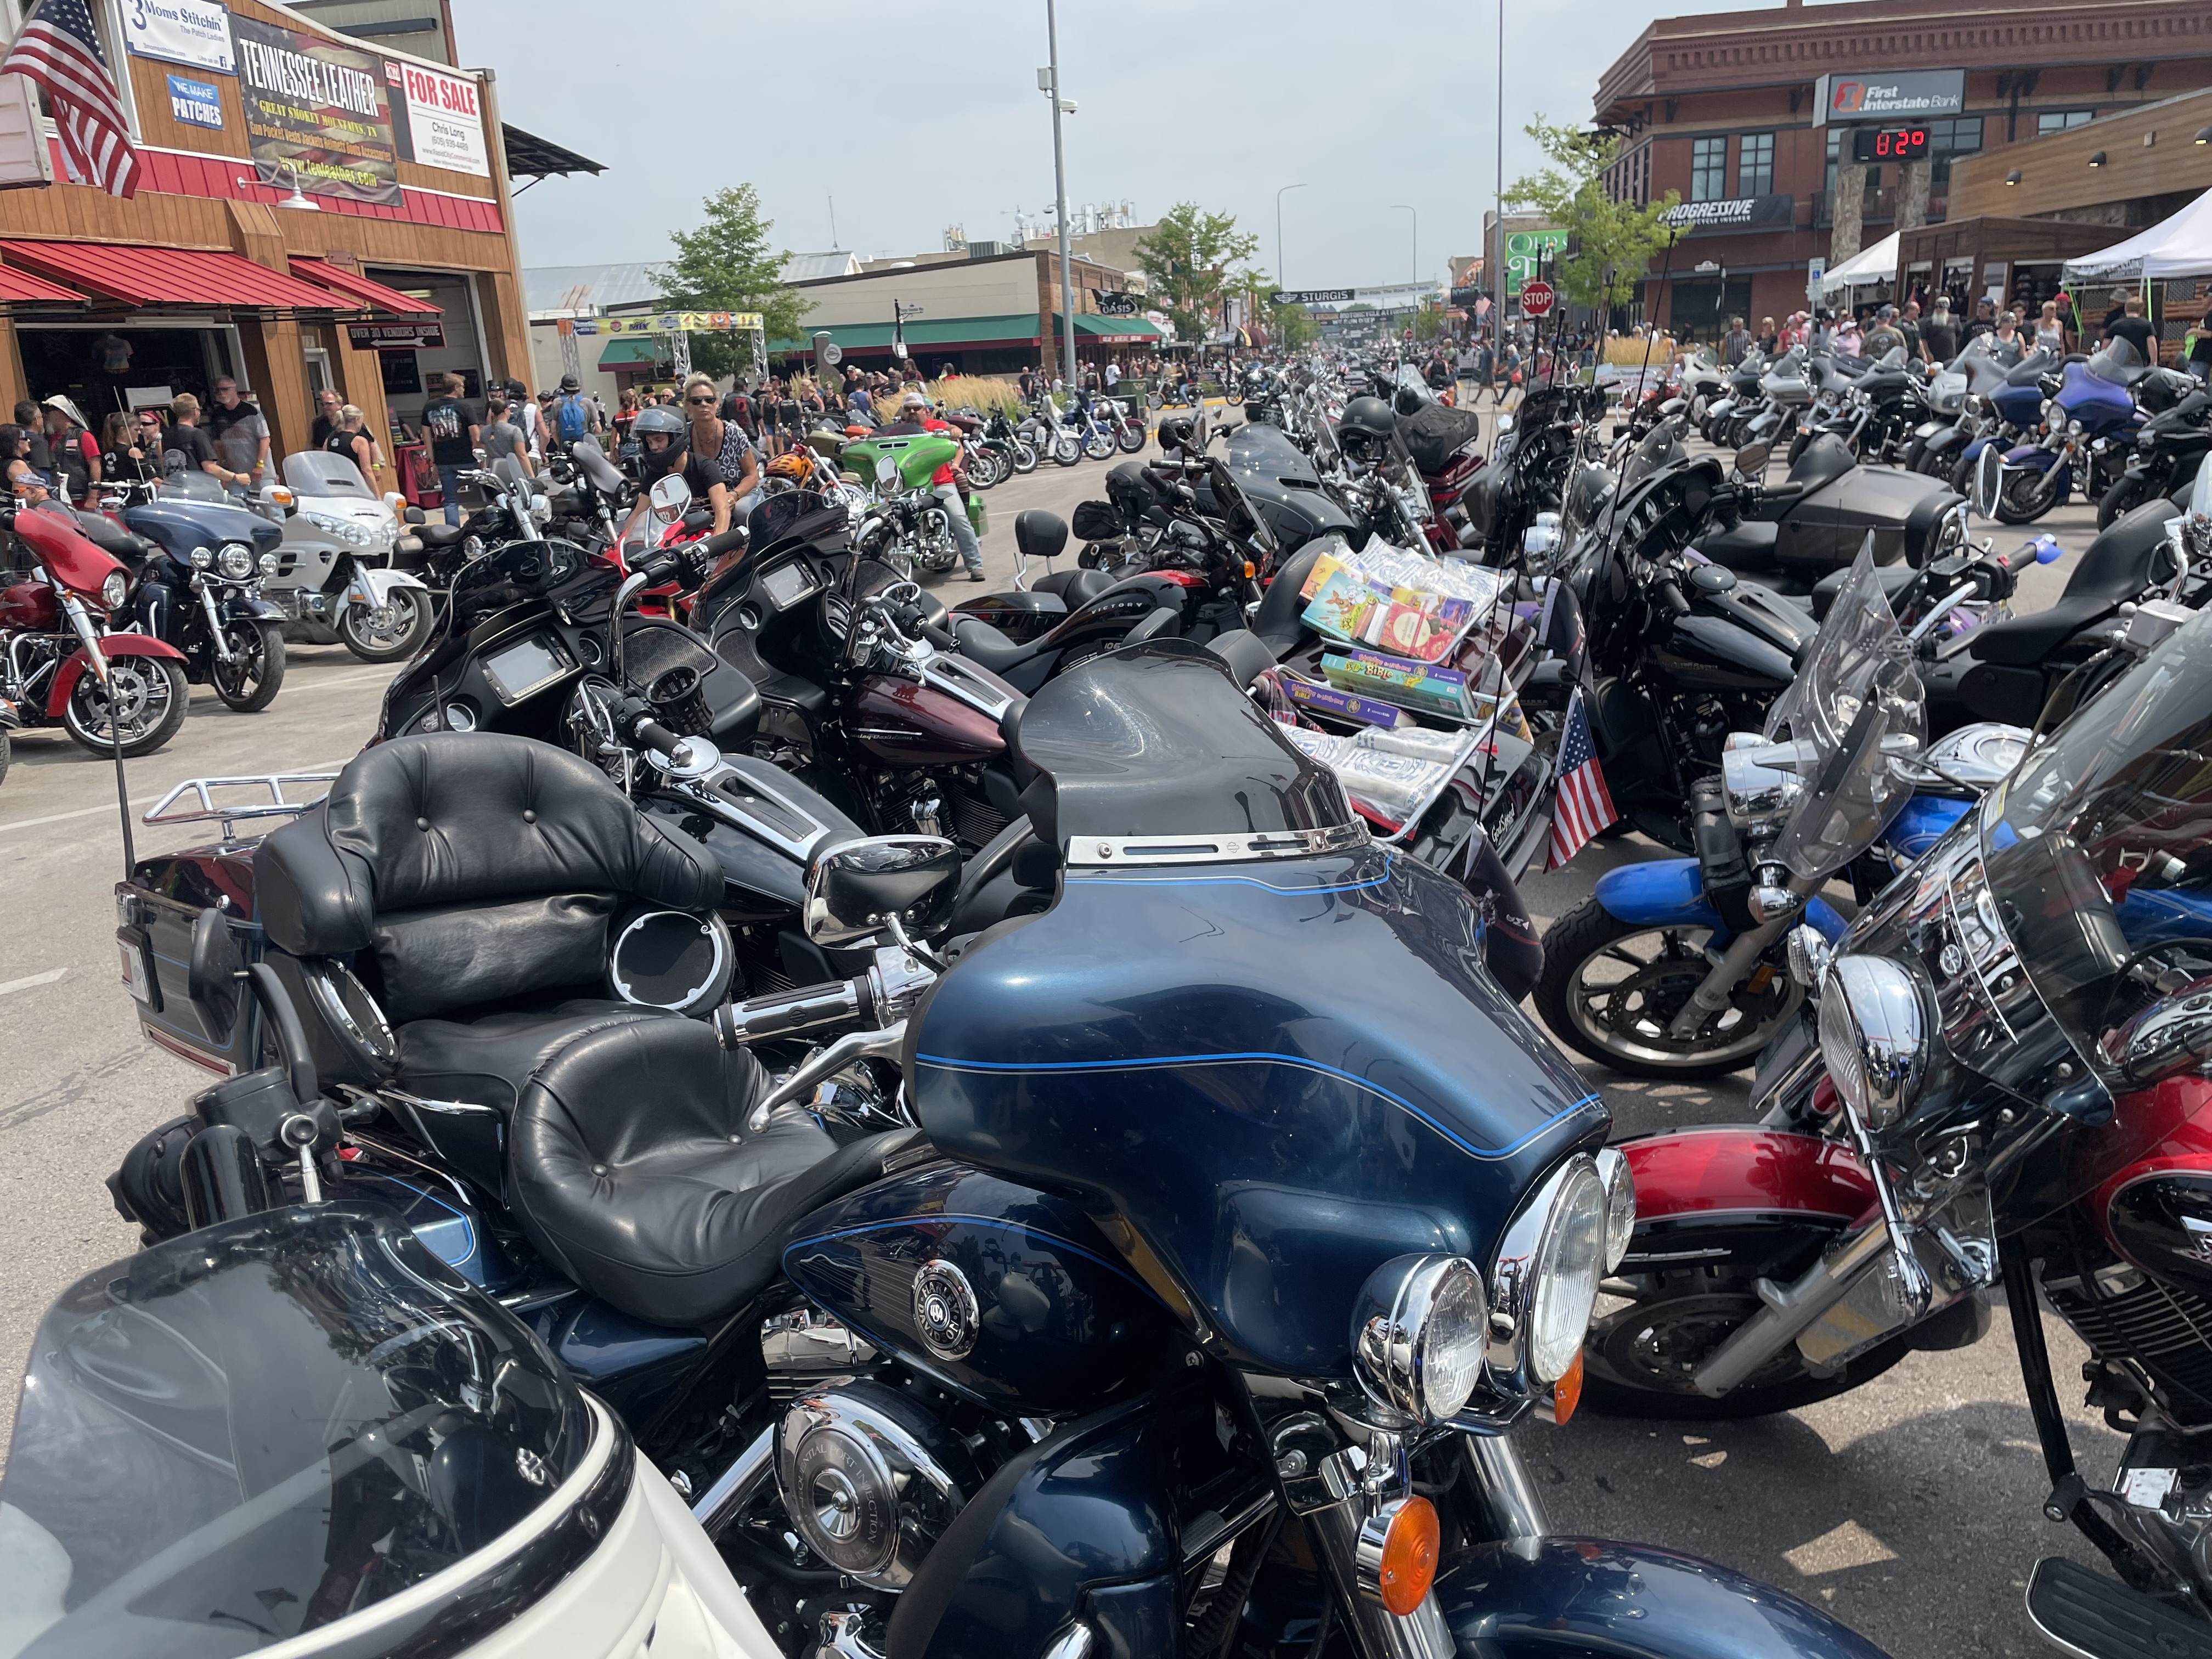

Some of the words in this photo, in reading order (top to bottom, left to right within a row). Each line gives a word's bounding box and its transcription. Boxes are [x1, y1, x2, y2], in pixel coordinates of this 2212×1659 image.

[132, 0, 146, 30] 3
[145, 0, 178, 20] Moms
[180, 8, 221, 31] Stitchin'
[180, 25, 190, 35] The
[192, 28, 206, 38] Patch
[207, 32, 224, 42] Ladies
[239, 38, 324, 104] TENNESSEE
[321, 61, 379, 117] LEATHER
[176, 82, 189, 94] WE
[189, 85, 213, 99] MAKE
[406, 70, 438, 106] FOR
[440, 79, 476, 116] SALE
[1866, 86, 1898, 99] First
[172, 97, 222, 126] PATCHES
[1864, 97, 1929, 111] Interstate
[1931, 94, 1960, 108] Bank
[259, 100, 286, 117] GREAT
[287, 107, 319, 125] SMOKEY
[321, 115, 366, 136] MOUNTAINS,
[366, 125, 377, 137] TN
[250, 121, 262, 135] Gun
[263, 125, 284, 140] Pocket
[285, 129, 301, 144] Vests
[302, 132, 324, 148] Jackets
[432, 122, 448, 135] Chris
[449, 126, 465, 140] Long
[279, 156, 377, 187] www.tenleather.com
[1301, 291, 1348, 302] STURGIS
[1523, 292, 1551, 307] STOP
[1102, 303, 1131, 314] OASIS
[351, 328, 370, 338] OVER
[370, 328, 381, 337] 30
[382, 326, 413, 337] VENDORS
[415, 326, 440, 337] INSIDE
[1091, 602, 1143, 614] VICTORY
[1294, 690, 1310, 699] BIBLE
[1492, 802, 1515, 845] GodSpeed
[922, 1282, 960, 1313] HARLEY
[918, 1304, 960, 1342] DAVIDSON
[830, 1444, 857, 1468] PORT
[856, 1470, 878, 1543] INJECTION
